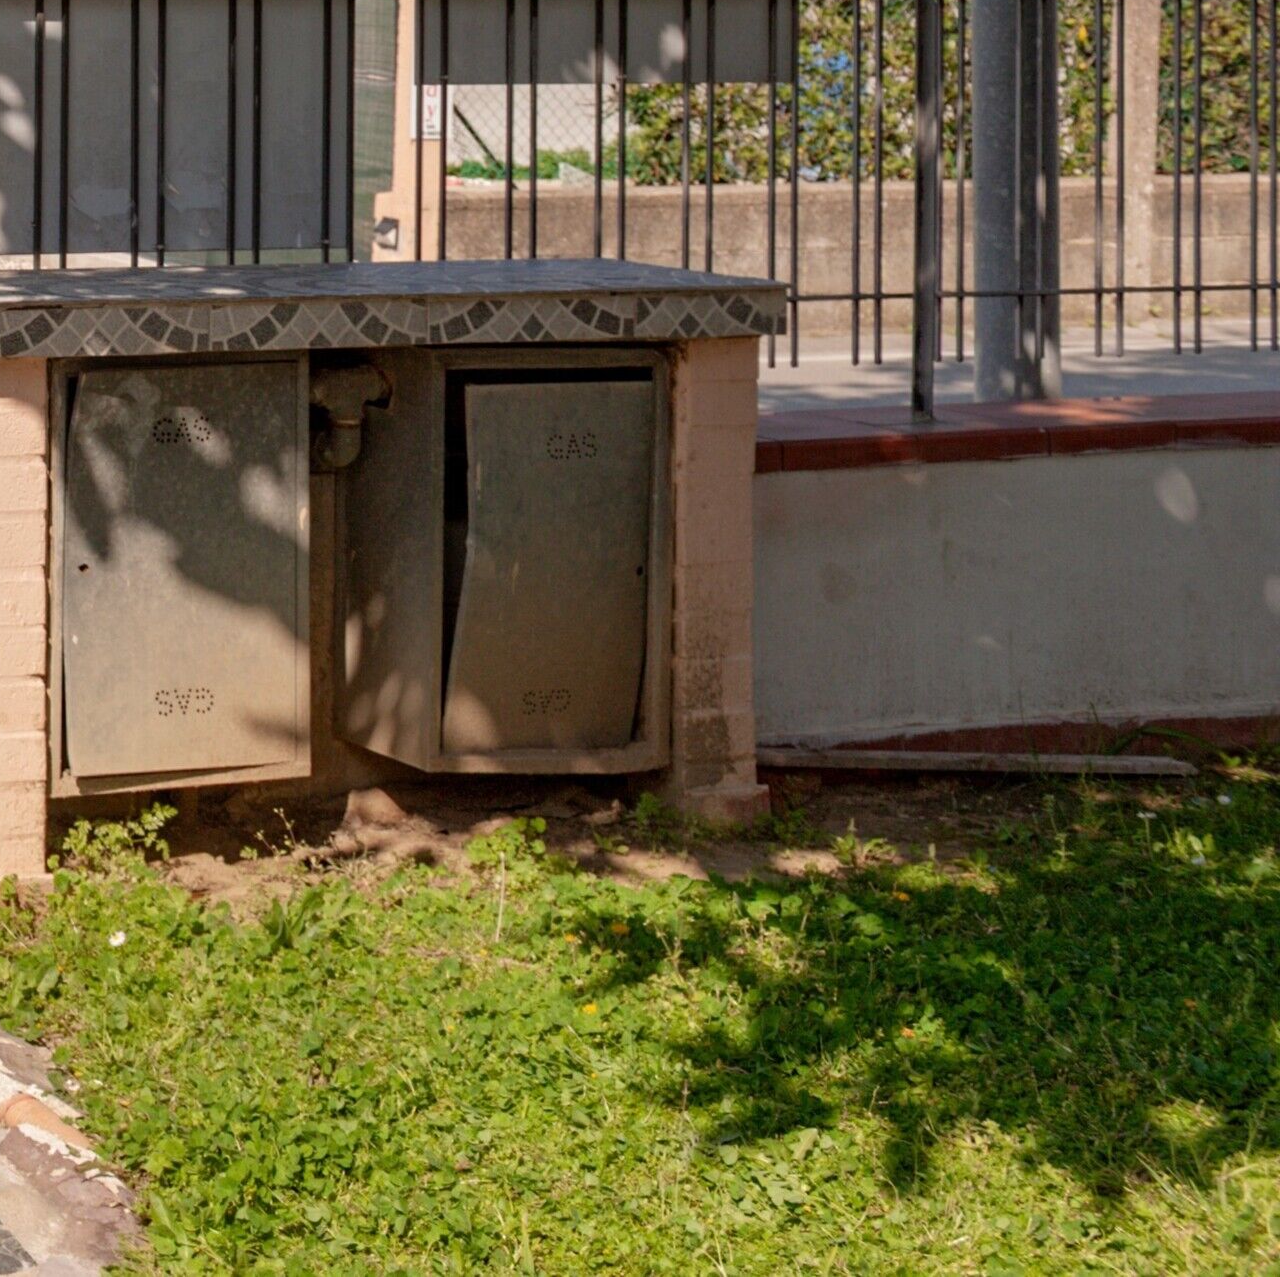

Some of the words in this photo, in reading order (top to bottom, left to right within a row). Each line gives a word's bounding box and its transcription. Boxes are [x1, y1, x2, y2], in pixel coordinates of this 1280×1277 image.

[152, 416, 210, 443] GAS
[546, 433, 598, 460] GAS
[154, 688, 214, 717] GAS
[522, 689, 572, 716] GAS
